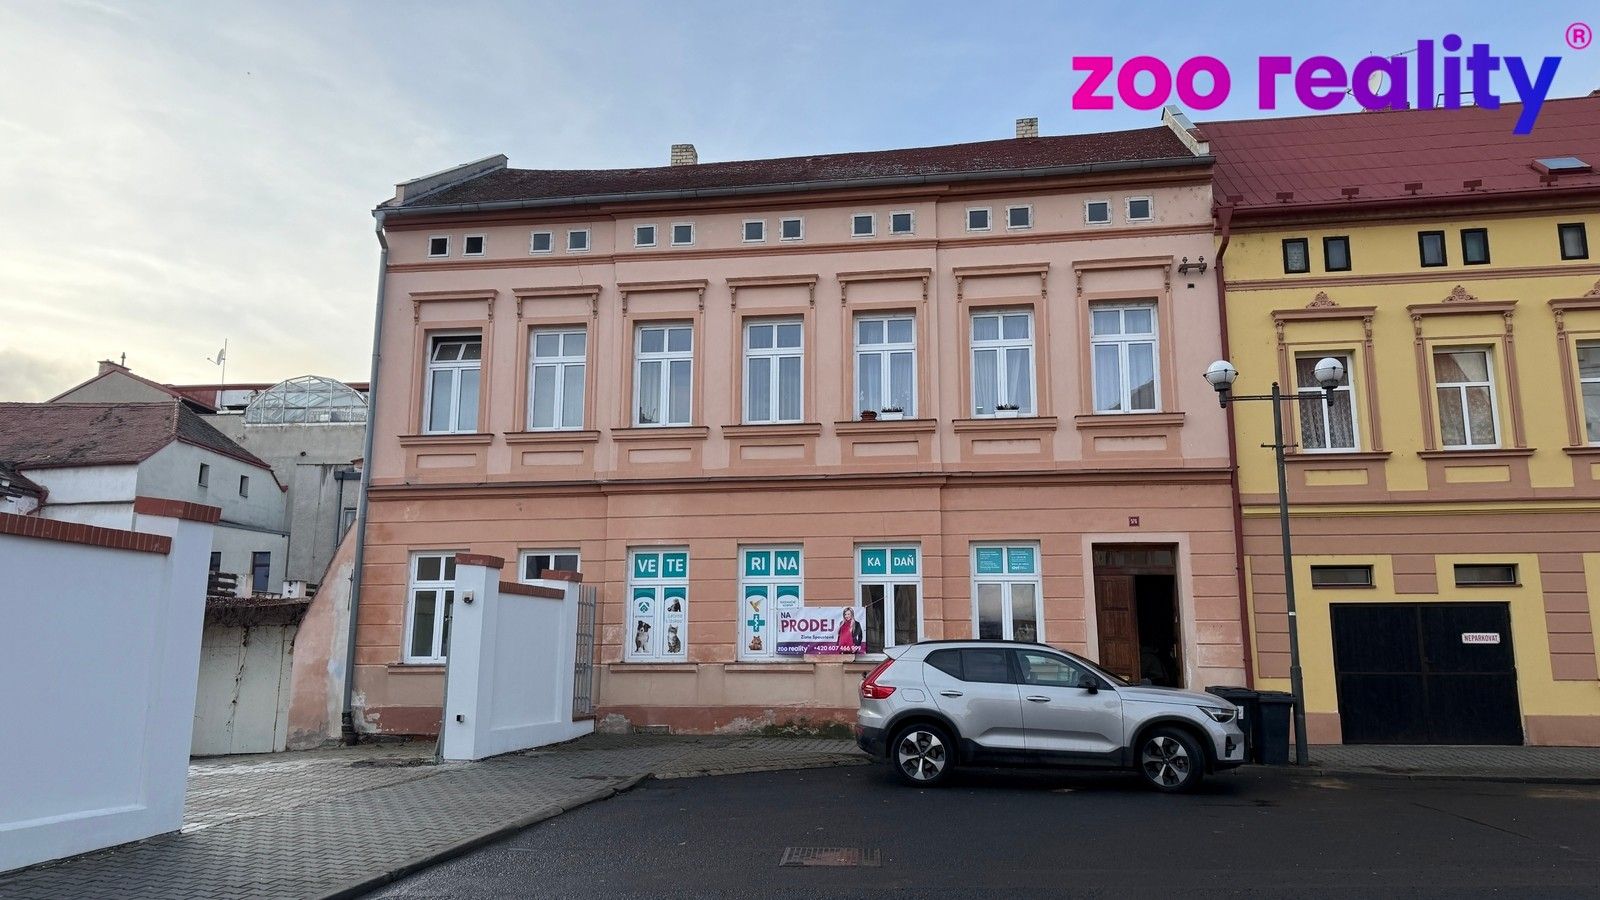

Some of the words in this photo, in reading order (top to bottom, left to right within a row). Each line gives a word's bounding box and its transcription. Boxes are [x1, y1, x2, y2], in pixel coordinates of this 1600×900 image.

[638, 559, 656, 572] VE
[666, 559, 684, 572] TE
[751, 557, 765, 570] RI
[777, 556, 798, 570] NA
[867, 557, 881, 567] KA
[894, 554, 914, 566] DAŇ
[781, 619, 835, 632] PRODEJ
